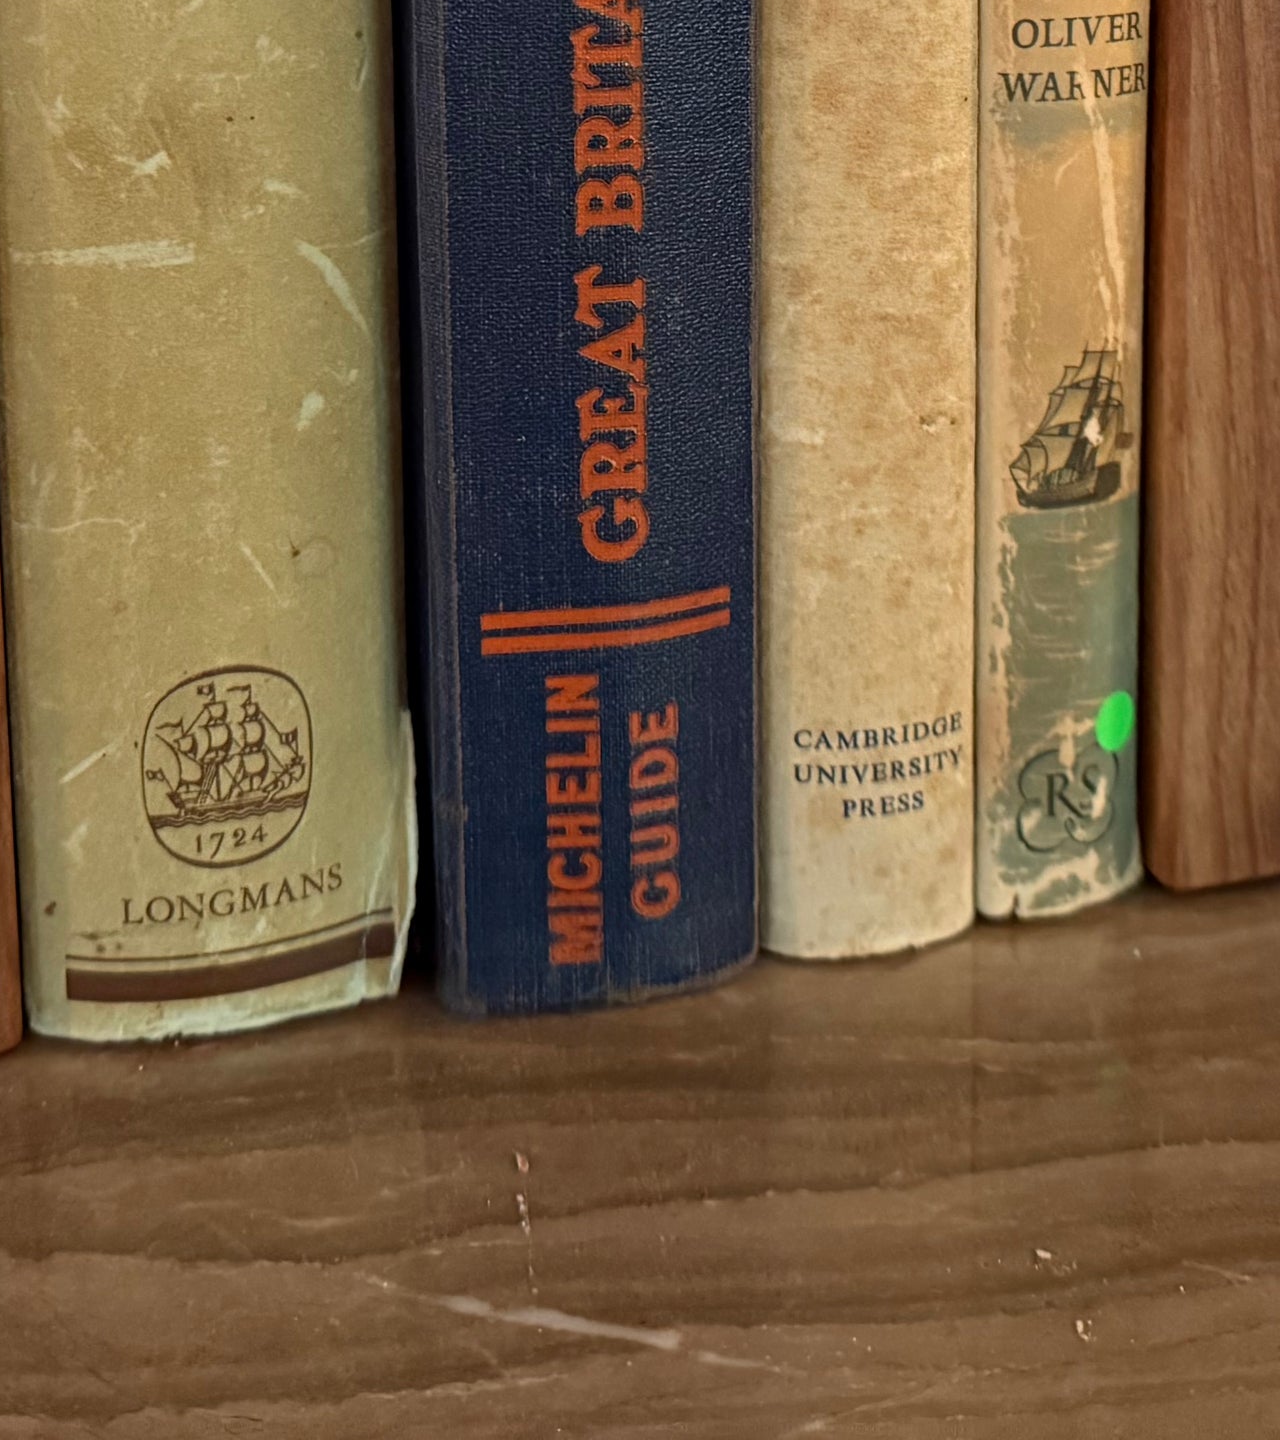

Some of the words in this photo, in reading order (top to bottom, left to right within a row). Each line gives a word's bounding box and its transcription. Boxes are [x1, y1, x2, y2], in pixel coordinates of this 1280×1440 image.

[1011, 11, 1142, 49] OLIVER
[997, 62, 1146, 102] WARNER
[576, 266, 650, 563] GREAT
[793, 711, 963, 750] CAMBRIDGE
[793, 746, 963, 785] UNIVERSITY
[545, 674, 605, 966] MICHELIN
[629, 699, 681, 918] GUIDE
[842, 790, 925, 818] PRESS
[194, 823, 268, 859] 1724
[122, 862, 343, 925] LONGMANS
